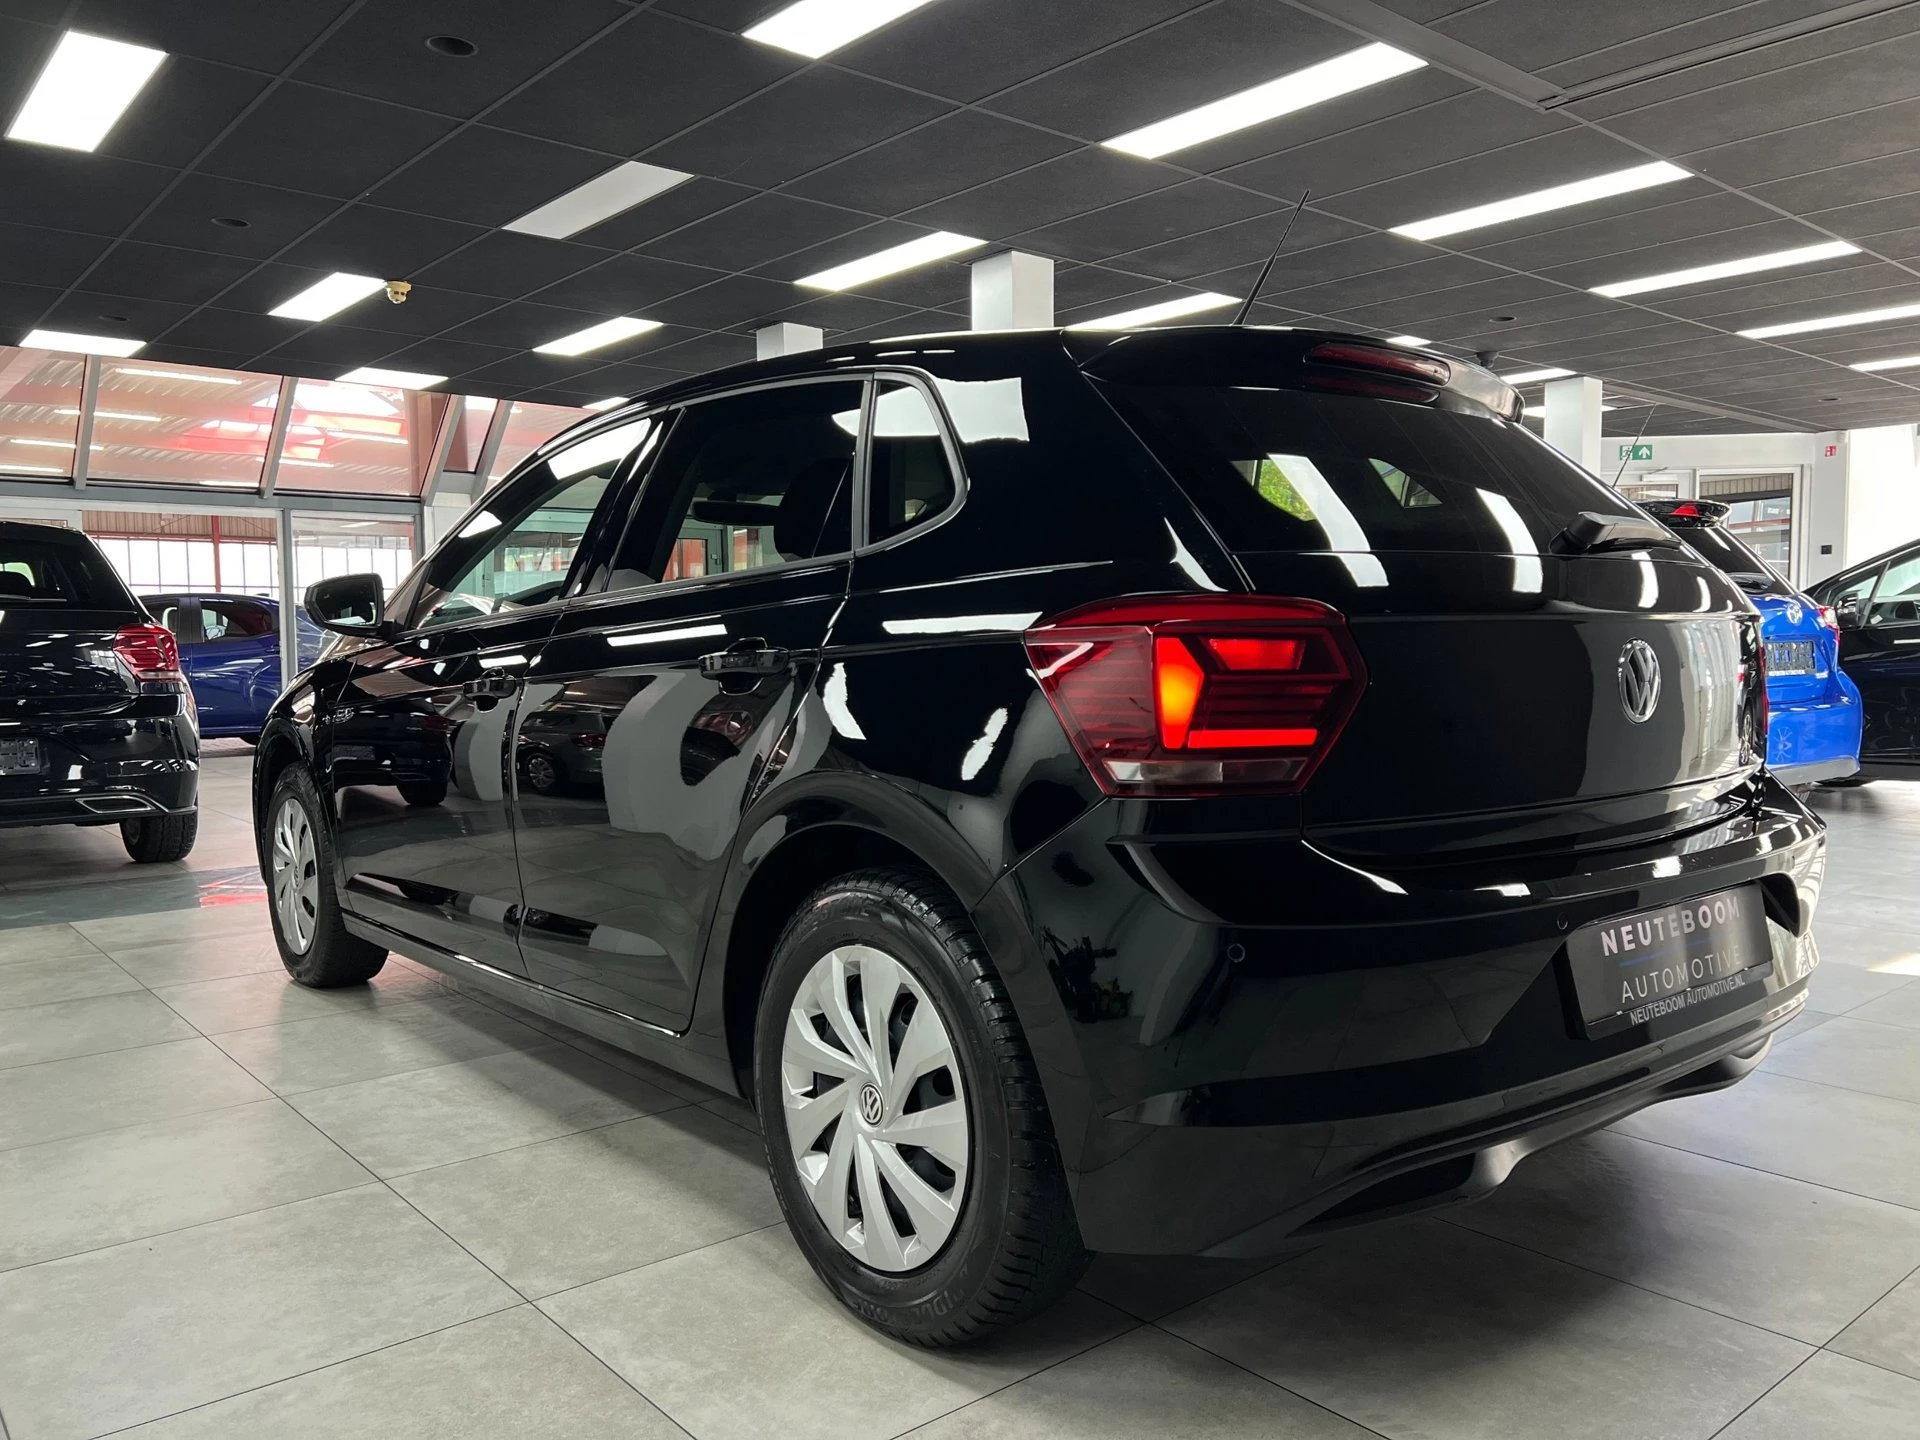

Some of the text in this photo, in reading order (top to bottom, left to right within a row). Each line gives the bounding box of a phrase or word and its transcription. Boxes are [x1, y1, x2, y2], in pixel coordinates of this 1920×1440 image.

[1600, 896, 1741, 957] NEUTEBOOM
[1621, 945, 1742, 1004] AUTOMOTIVE
[1629, 974, 1746, 1027] NEUTEBOOM AUTOMOTIVE.NL
